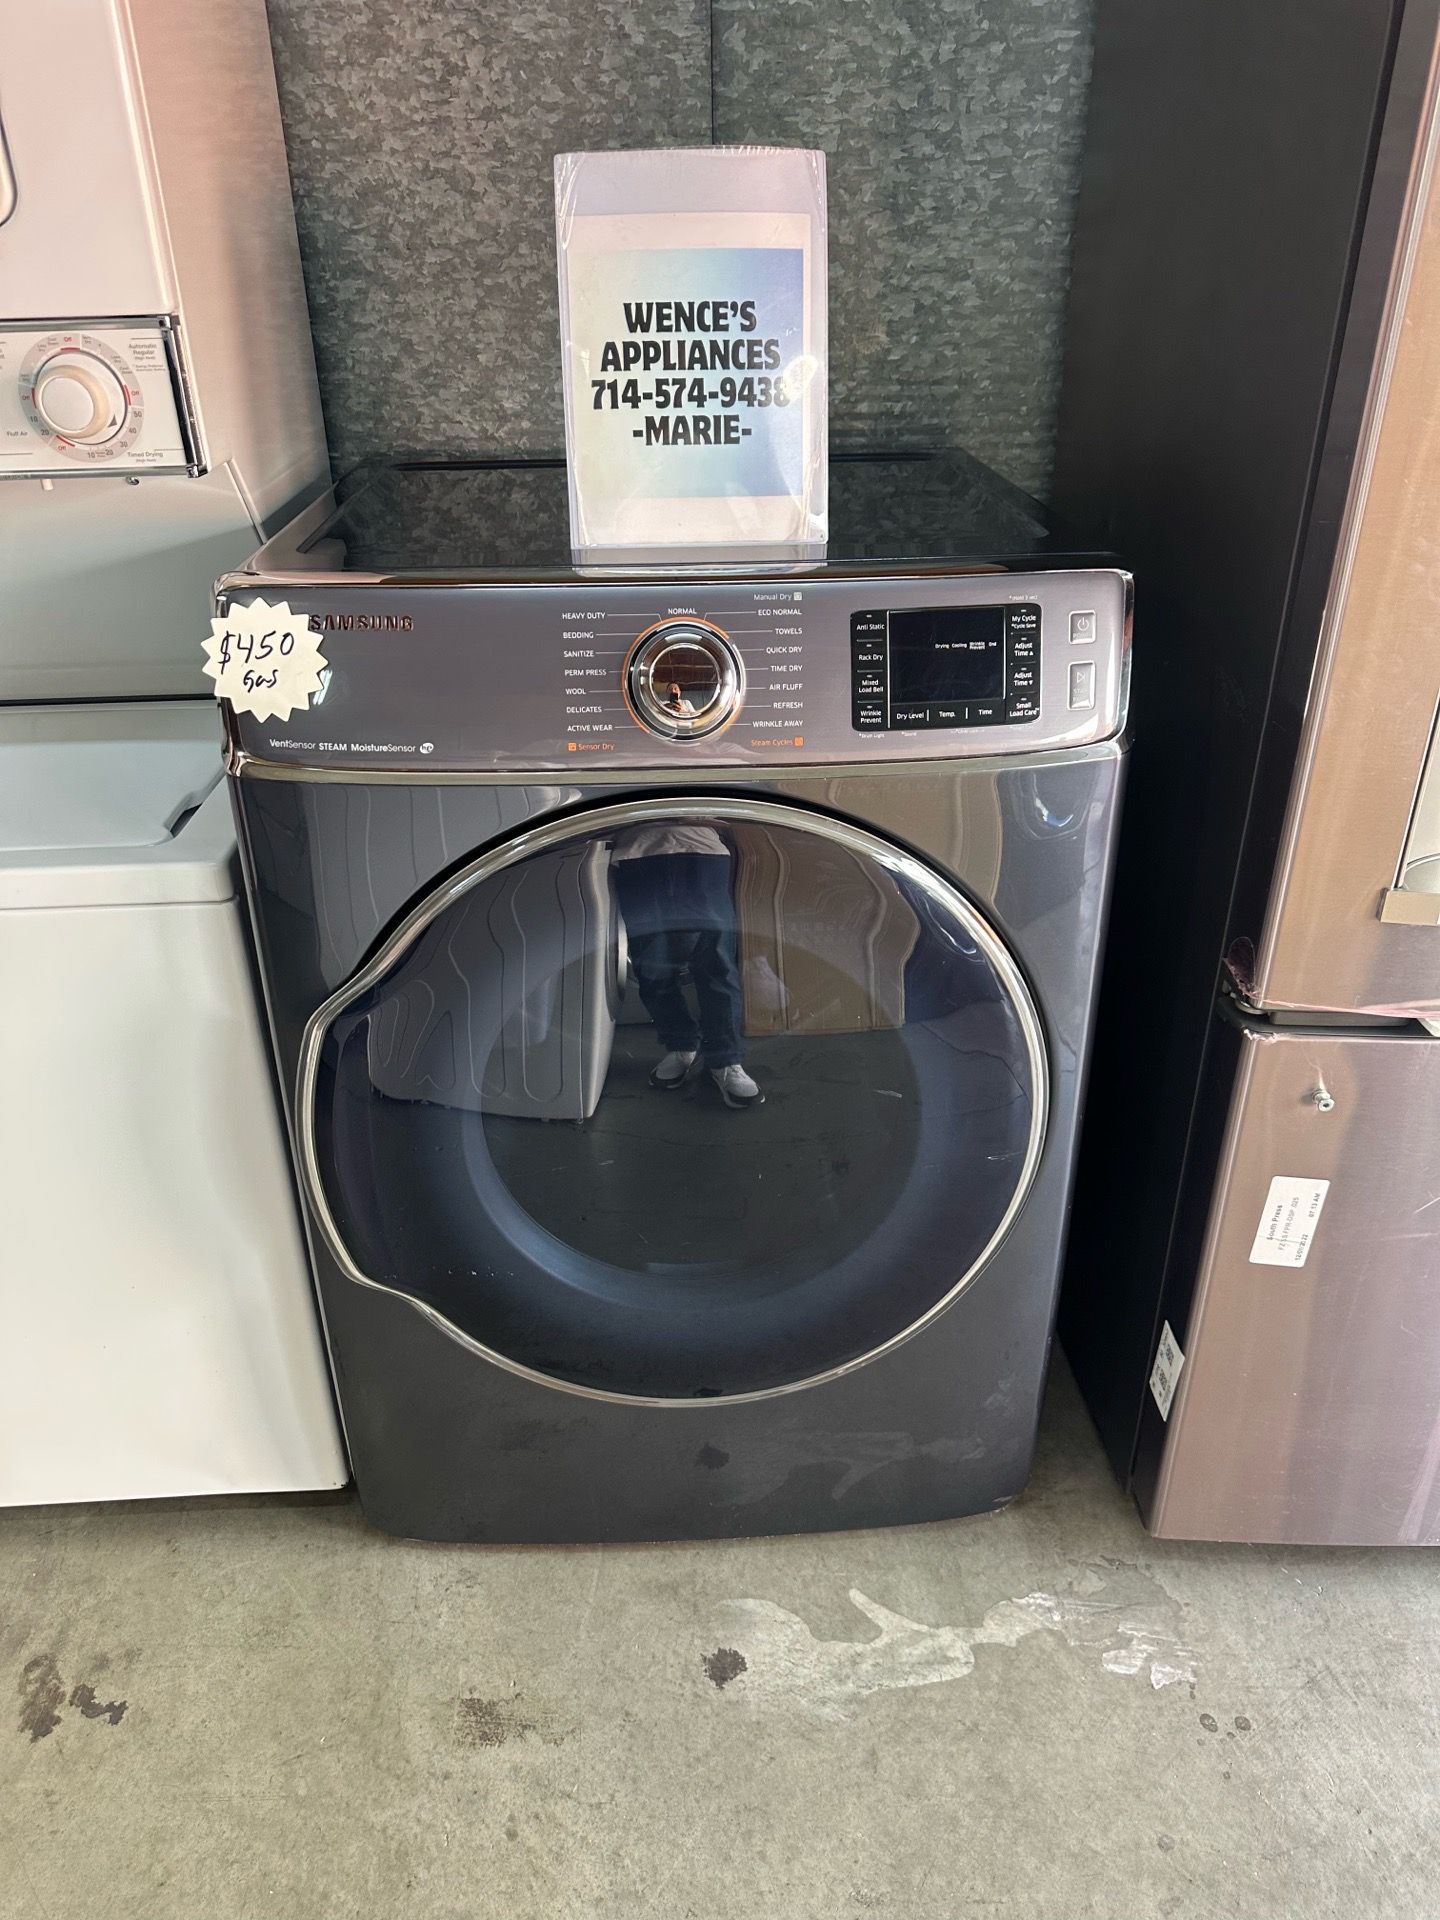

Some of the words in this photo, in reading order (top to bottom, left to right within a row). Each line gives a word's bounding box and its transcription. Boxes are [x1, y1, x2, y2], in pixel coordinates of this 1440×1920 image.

[623, 300, 757, 333] WENCE’S
[600, 338, 781, 371] APPLIANCES
[591, 377, 790, 409] 714-574-9438
[633, 414, 752, 446] -MARIE-
[780, 593, 792, 602] Dry
[310, 614, 414, 632] SAMSUNG
[218, 630, 295, 675] $450
[243, 669, 278, 692] Gas
[269, 738, 316, 750] VentSensor
[319, 743, 348, 751] STEAM
[350, 744, 416, 752] MoistureSensor
[602, 743, 614, 751] Dry
[1312, 1192, 1320, 1203] AM
[1272, 1205, 1283, 1222] Press
